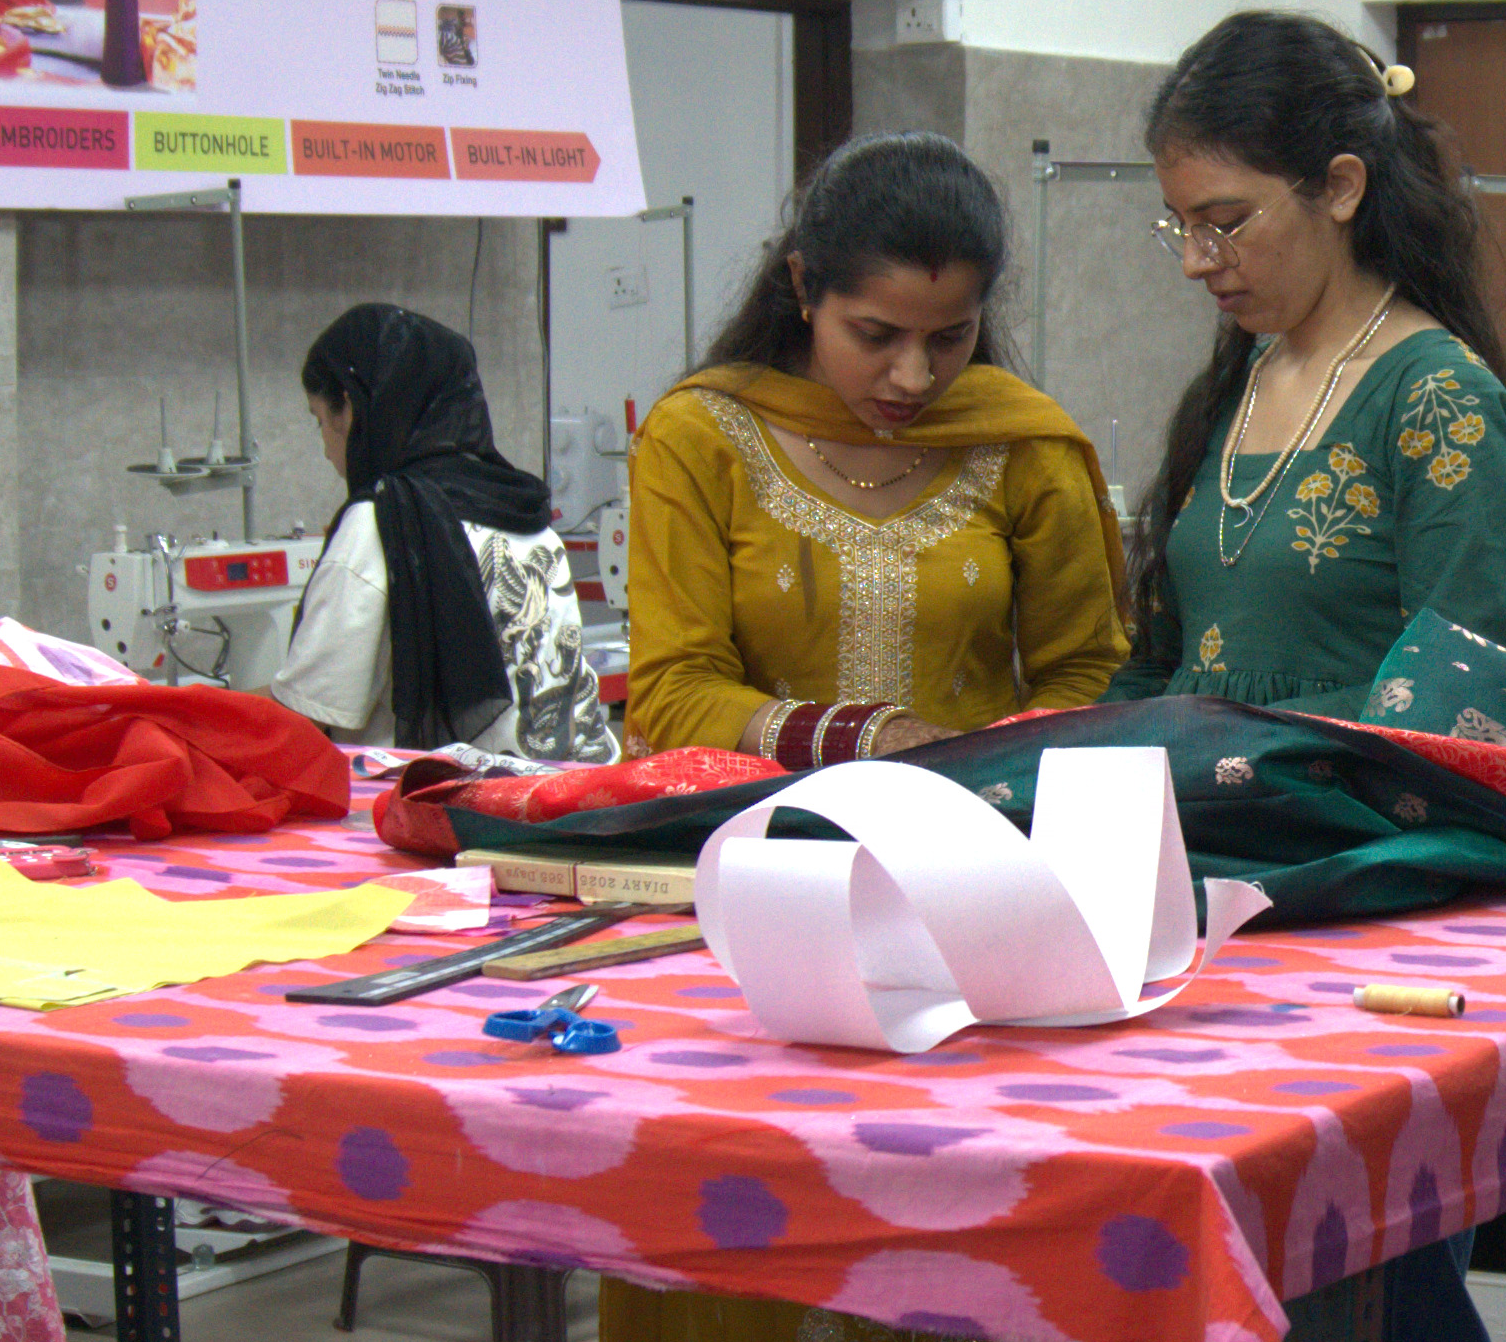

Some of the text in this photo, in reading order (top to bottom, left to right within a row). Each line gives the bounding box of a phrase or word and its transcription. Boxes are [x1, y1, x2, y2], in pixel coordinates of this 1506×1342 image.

[153, 131, 270, 157] BUTTONHOLE
[302, 137, 437, 163] BUILT-IN MOTOR
[467, 144, 586, 168] BUILT-IN LIGHT
[506, 867, 565, 885] 365 Days
[581, 874, 669, 894] DIARY 2025
